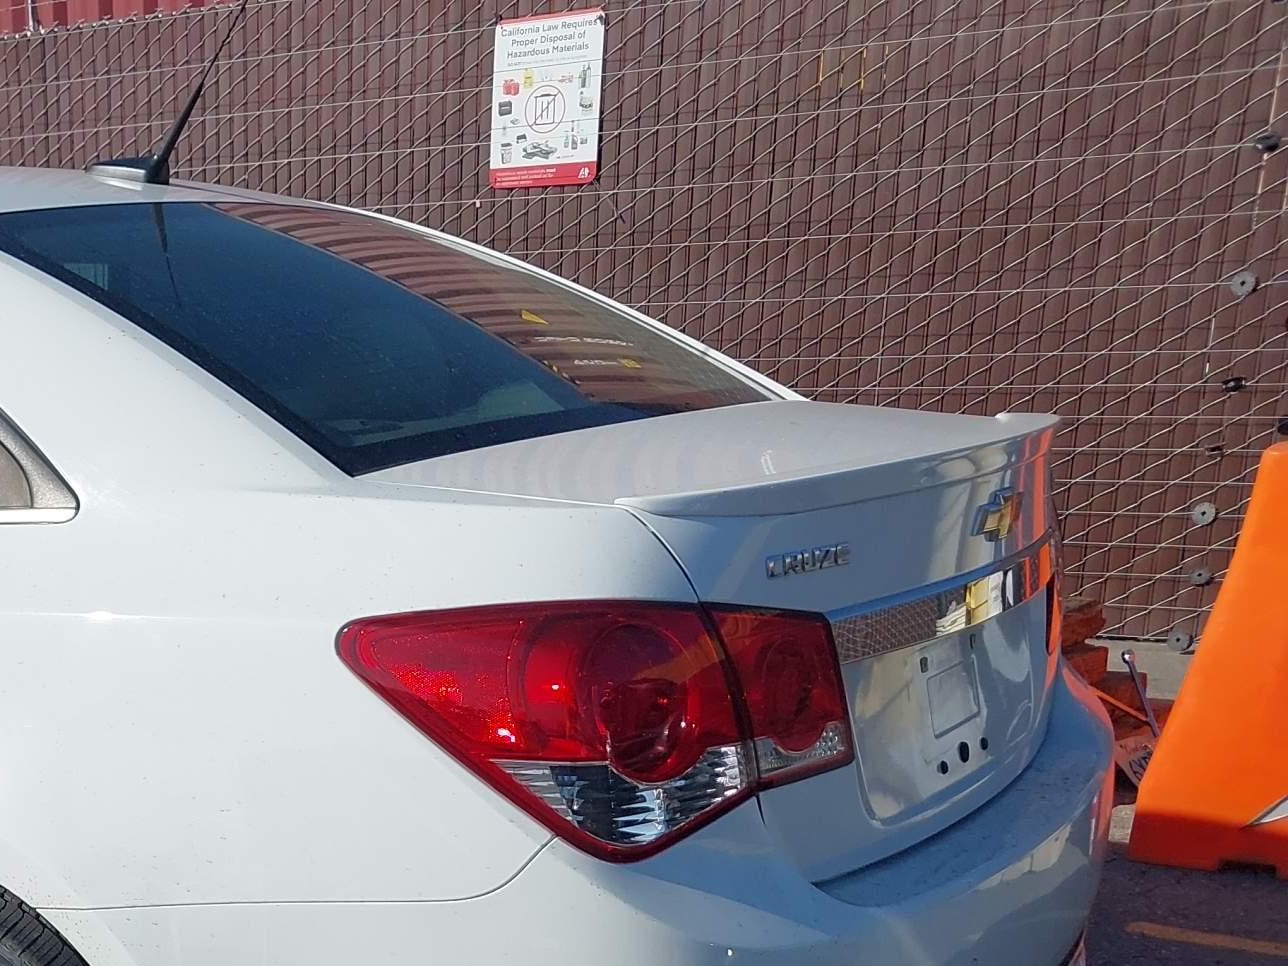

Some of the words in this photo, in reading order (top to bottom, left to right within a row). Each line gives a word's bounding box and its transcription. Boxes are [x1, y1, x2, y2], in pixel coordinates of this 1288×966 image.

[501, 25, 540, 37] California
[542, 23, 559, 32] Law
[561, 18, 598, 31] Requires
[511, 38, 538, 47] Proper
[540, 31, 576, 43] Disposal
[577, 30, 586, 39] of
[507, 48, 550, 59] Hazardous
[552, 42, 590, 53] Materials
[765, 542, 850, 577] CRUZE
